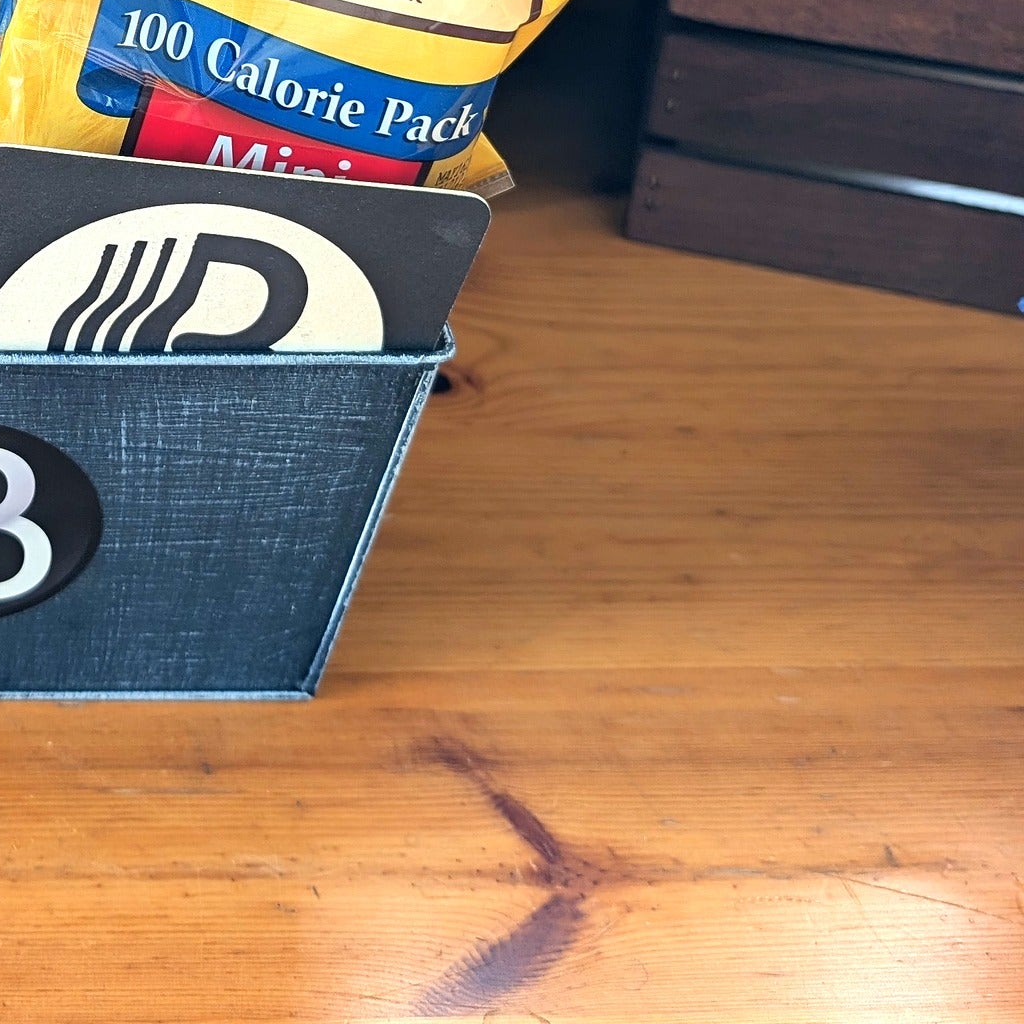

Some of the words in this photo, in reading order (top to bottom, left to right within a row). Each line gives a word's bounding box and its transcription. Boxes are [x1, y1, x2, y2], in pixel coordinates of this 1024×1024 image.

[116, 9, 194, 61] 100
[206, 37, 366, 128] Calorie
[374, 95, 479, 144] Pack
